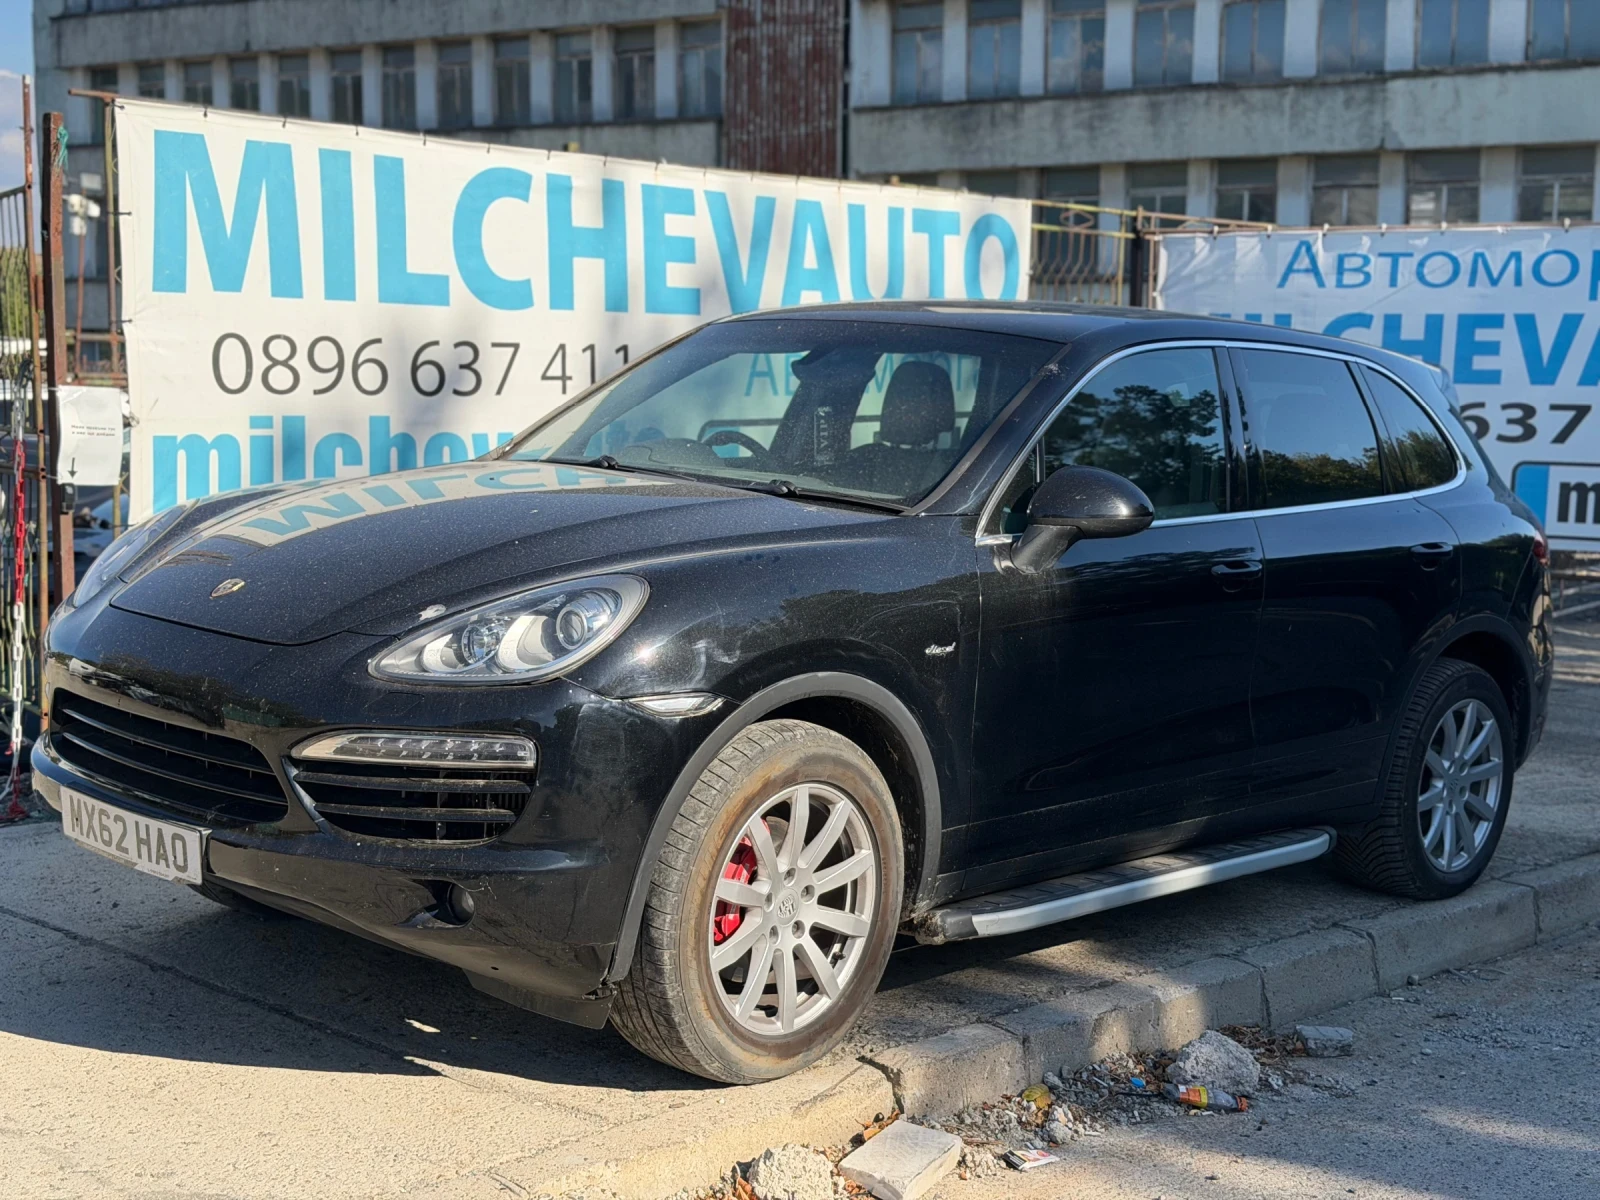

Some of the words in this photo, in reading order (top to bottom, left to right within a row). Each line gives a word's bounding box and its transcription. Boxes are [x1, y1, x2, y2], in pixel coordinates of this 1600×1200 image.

[152, 129, 1020, 315] MILCHEVAUTO
[211, 332, 389, 395] 0896
[410, 340, 521, 397] 637
[69, 794, 130, 856] MX62
